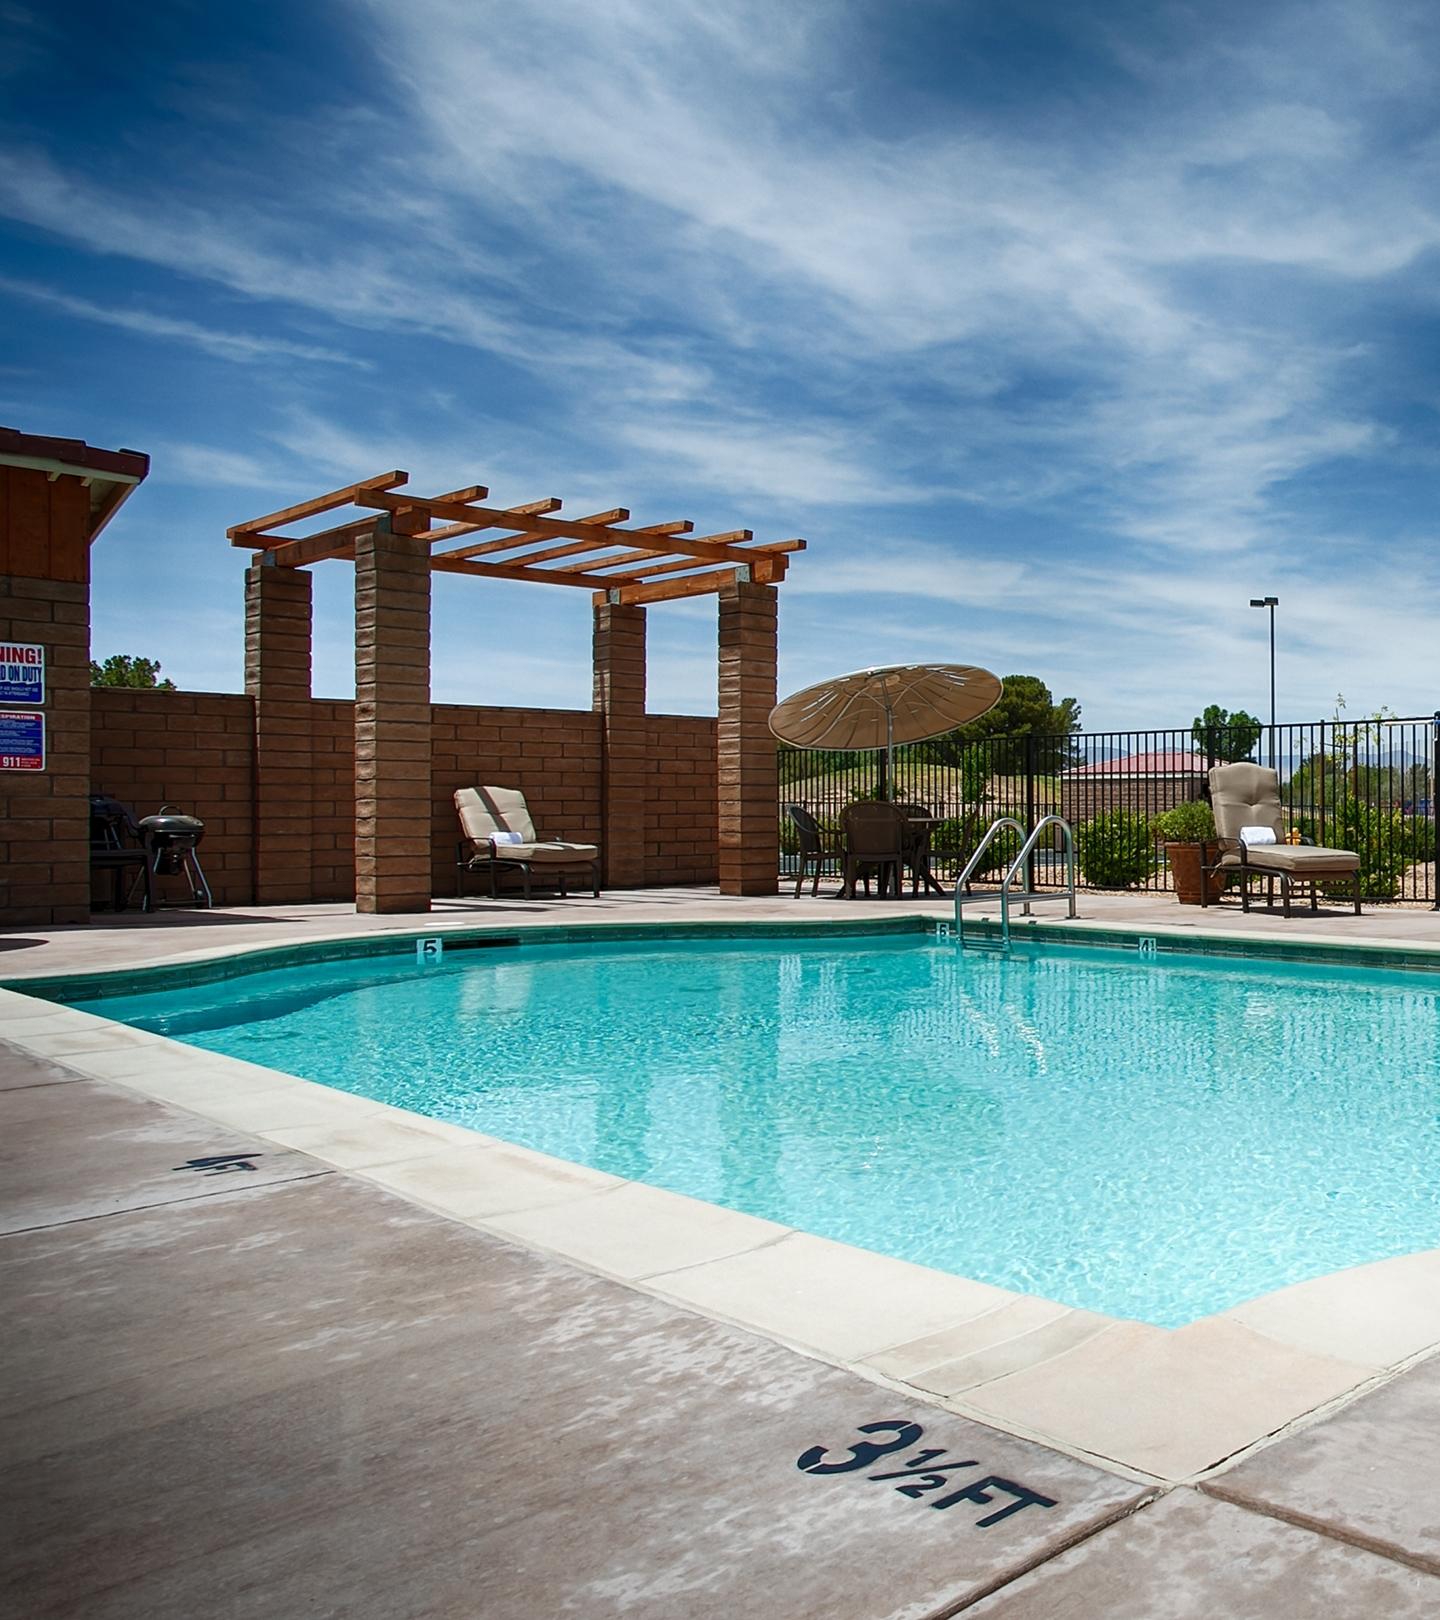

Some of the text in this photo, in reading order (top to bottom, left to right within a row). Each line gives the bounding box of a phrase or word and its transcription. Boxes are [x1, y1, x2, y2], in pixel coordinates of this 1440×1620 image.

[8, 665, 20, 682] ON
[22, 666, 42, 683] DUTY
[3, 757, 20, 767] 911
[423, 940, 438, 953] 5
